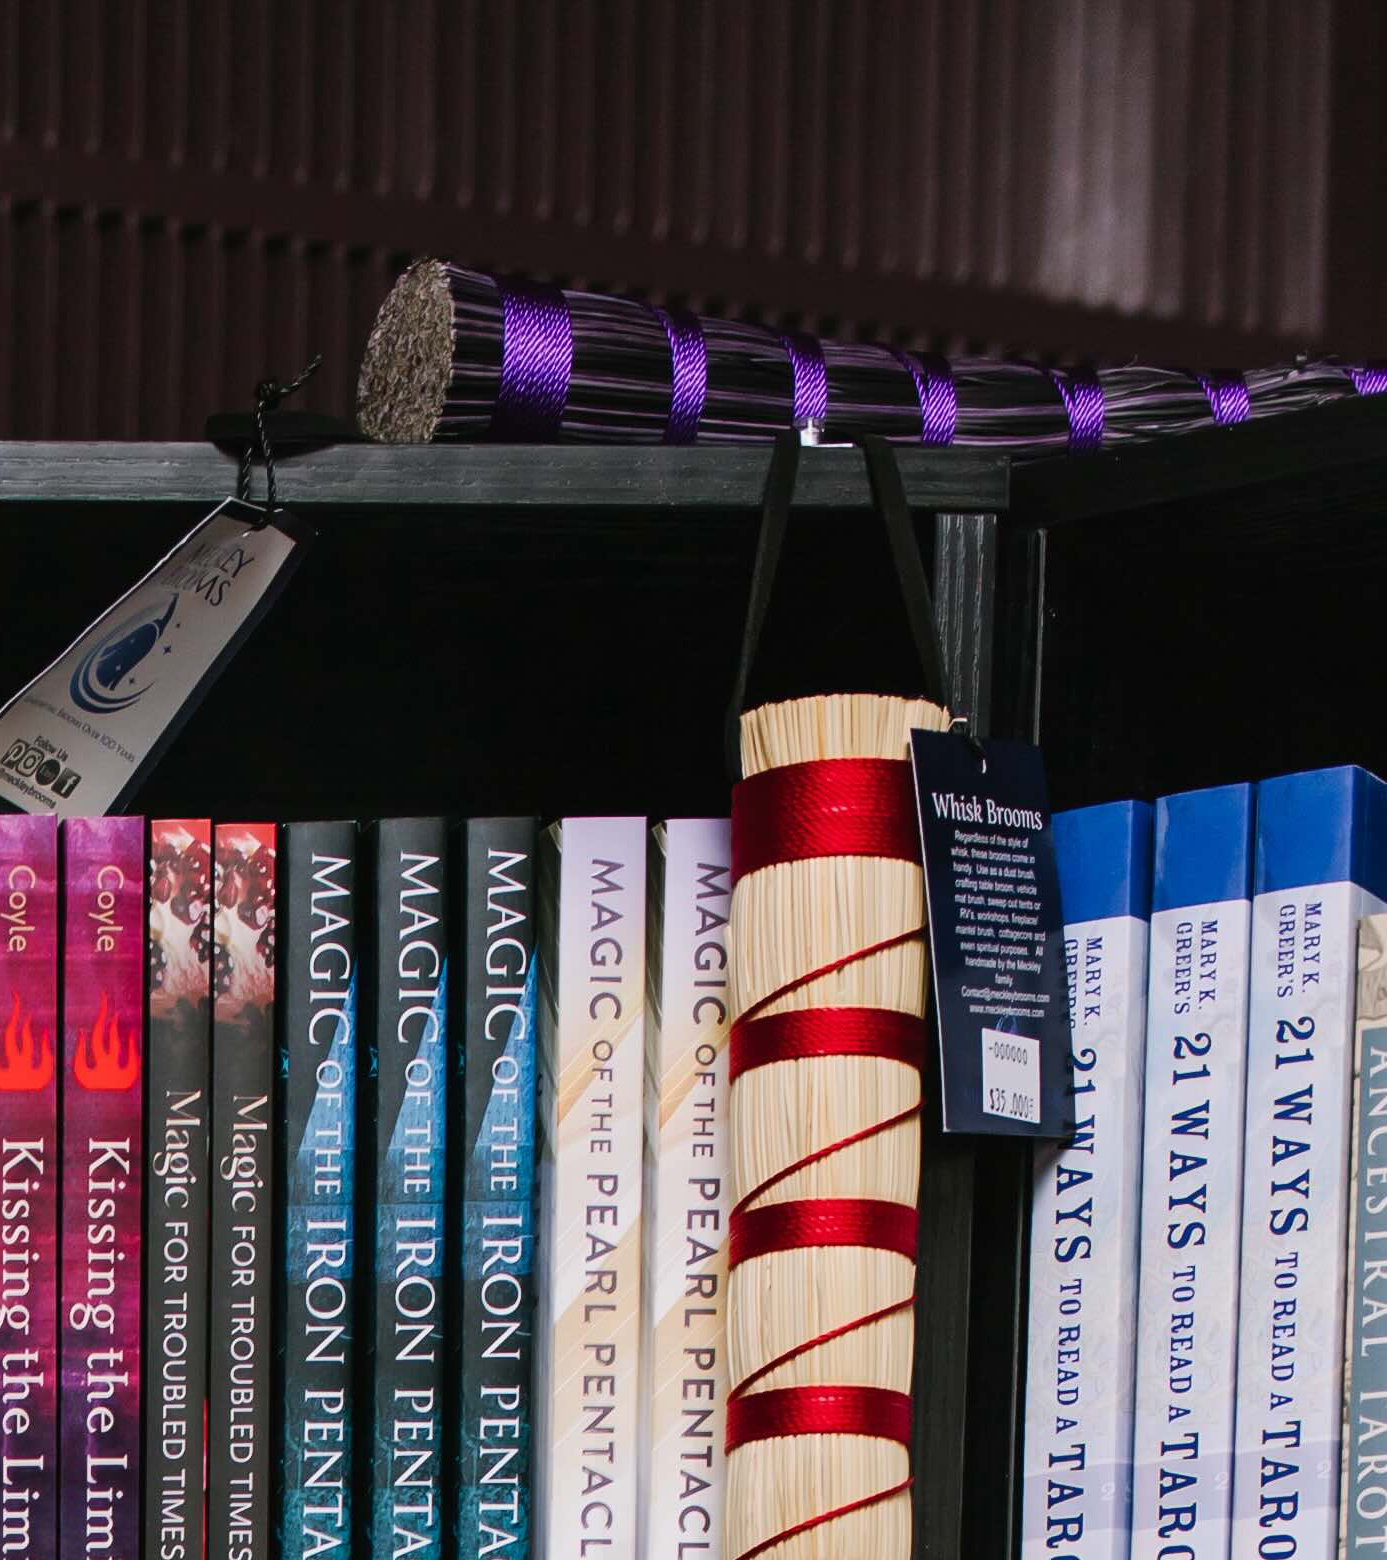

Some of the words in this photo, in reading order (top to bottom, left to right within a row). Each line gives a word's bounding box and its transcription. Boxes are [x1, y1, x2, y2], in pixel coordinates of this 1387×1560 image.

[932, 792, 983, 824] Whisk
[986, 798, 1042, 831] Brooms
[4, 864, 37, 953] Coyle
[1274, 1015, 1317, 1072] 21
[153, 1089, 202, 1209] Magic
[1265, 1084, 1313, 1237] WAYS
[162, 1221, 187, 1269] FOR
[1274, 1251, 1299, 1289] TO
[161, 1278, 189, 1455] TROUBLED
[1271, 1298, 1297, 1382] READ
[2, 1348, 44, 1435] the
[1269, 1392, 1294, 1411] A
